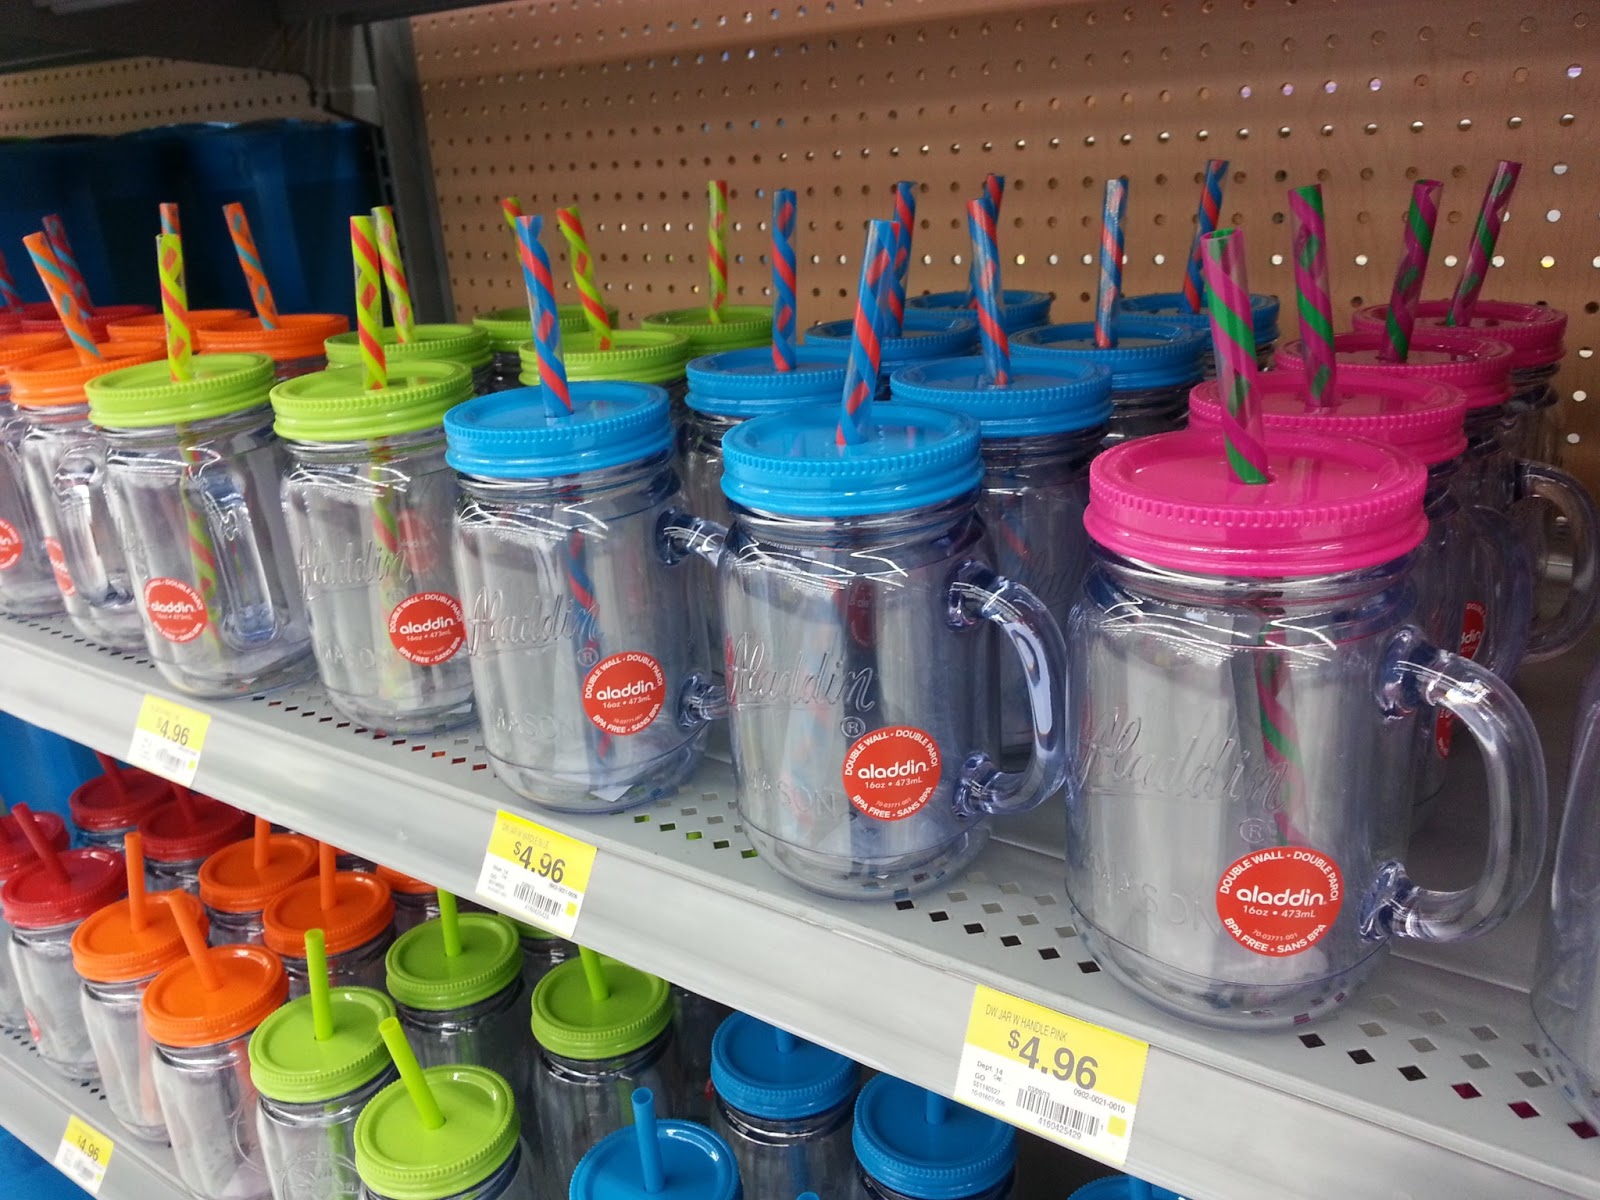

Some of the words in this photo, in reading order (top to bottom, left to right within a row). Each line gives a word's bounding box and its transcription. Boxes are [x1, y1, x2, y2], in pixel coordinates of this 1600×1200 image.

[424, 594, 452, 606] DOUBLE
[400, 616, 454, 634] aladdin
[412, 655, 430, 663] FREE
[728, 632, 875, 712] Aladdin
[584, 669, 602, 698] DOUBLE
[600, 657, 621, 671] WALL
[626, 654, 654, 668] DOUBLE
[652, 665, 663, 686] PAROI
[596, 680, 654, 700] aladdin
[593, 714, 606, 728] BPA
[606, 724, 626, 733] FREE
[631, 717, 650, 732] SANS
[845, 743, 866, 776] DOUBLE
[863, 732, 889, 746] WALL
[896, 730, 928, 746] DOUBLE
[926, 743, 938, 767] PAROI
[858, 760, 926, 778] aladdin
[895, 776, 922, 786] 473mL
[853, 794, 868, 810] BPA
[868, 806, 890, 818] FREE
[897, 801, 920, 817] SANS
[918, 786, 932, 803] BPA
[514, 841, 566, 883] $4.96
[1220, 859, 1252, 894] DOUBLE
[1251, 850, 1284, 864] WALL
[1293, 851, 1332, 874] DOUBLE
[1327, 872, 1339, 902] PAROI
[1236, 885, 1324, 906] aladdin
[1243, 905, 1268, 916] 16oz
[1282, 910, 1316, 918] 473mL
[1224, 918, 1242, 938] BPA
[1240, 935, 1269, 952] FREE
[1277, 939, 1308, 953] SANS
[1307, 924, 1327, 942] BPA
[985, 1004, 998, 1016] DW
[999, 1008, 1012, 1022] JAR
[1014, 1014, 1020, 1024] W
[1020, 1016, 1050, 1036] HANDLE
[1050, 1026, 1068, 1042] PINK
[1008, 1029, 1098, 1090] $4.96
[1073, 1088, 1126, 1114] 0902-0021-0010
